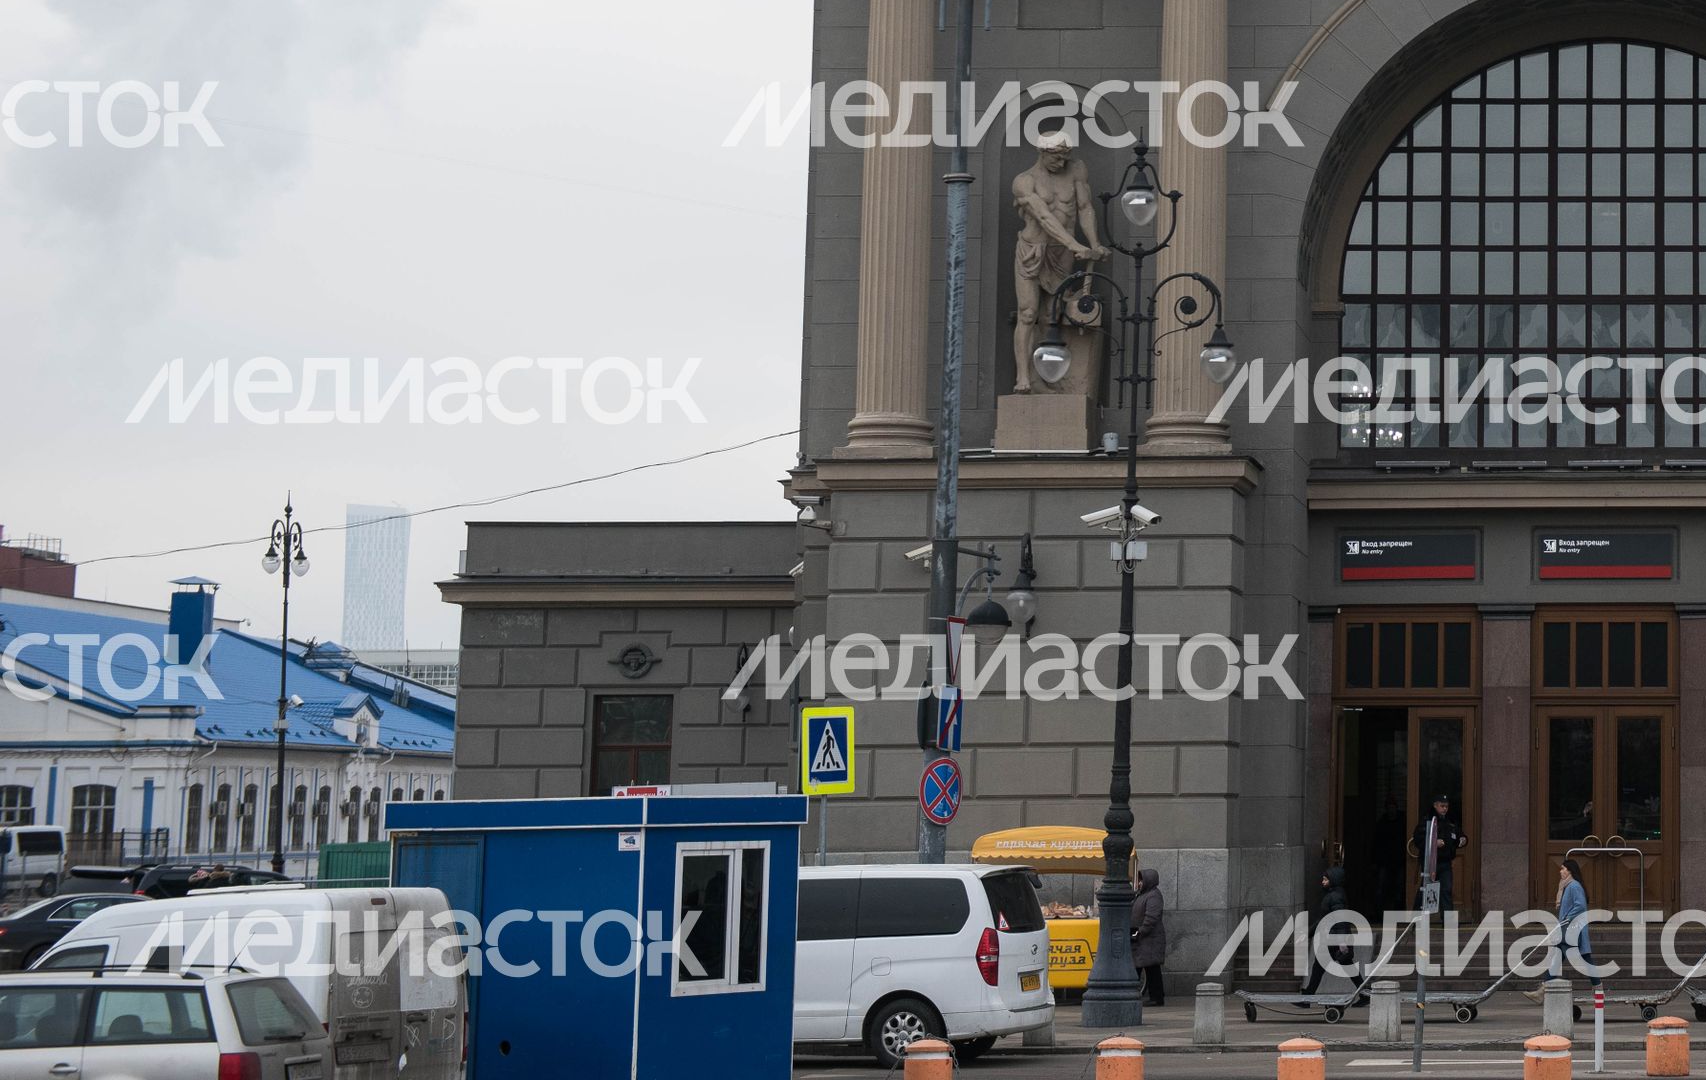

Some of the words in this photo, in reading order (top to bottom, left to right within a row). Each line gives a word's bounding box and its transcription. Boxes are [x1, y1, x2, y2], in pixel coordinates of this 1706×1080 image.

[1361, 540, 1378, 548] Вход
[1379, 540, 1413, 548] запрещен
[1558, 539, 1575, 547] Вход
[1576, 539, 1610, 547] запрещен
[1050, 840, 1103, 851] кукуруз
